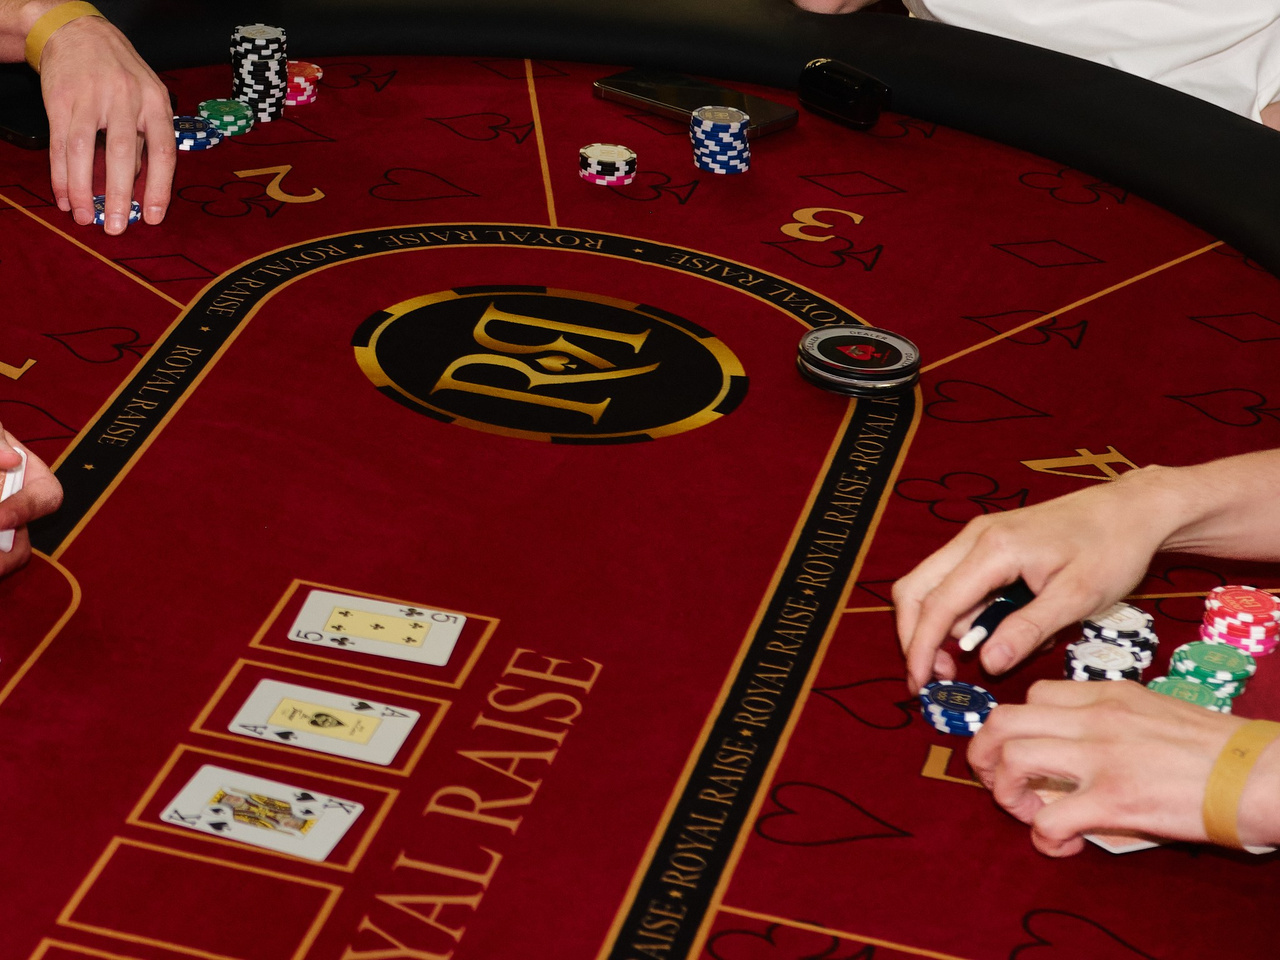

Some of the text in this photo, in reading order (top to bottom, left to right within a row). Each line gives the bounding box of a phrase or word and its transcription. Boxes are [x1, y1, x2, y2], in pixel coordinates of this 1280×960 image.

[234, 165, 326, 203] 2
[377, 229, 603, 250] ROYAL RAISE
[780, 207, 864, 242] 3
[206, 243, 347, 318] ROYAL RAISE
[665, 252, 765, 288] RAISE
[849, 330, 888, 341] DEALER
[97, 344, 203, 448] ROYAL RAISE
[849, 412, 898, 465] ROYAL
[1020, 445, 1140, 481] 4
[796, 472, 872, 588] ROYAL RAISE
[296, 630, 324, 642] 5
[431, 613, 458, 625] 5
[733, 596, 820, 728] ROYAL RAISE
[238, 723, 269, 736] A
[381, 707, 411, 719] A
[168, 809, 203, 827] K
[322, 798, 357, 815] K
[340, 647, 604, 960] YAL RAISE
[661, 737, 759, 889] ROYAL RAISE
[628, 899, 688, 960] AISE
